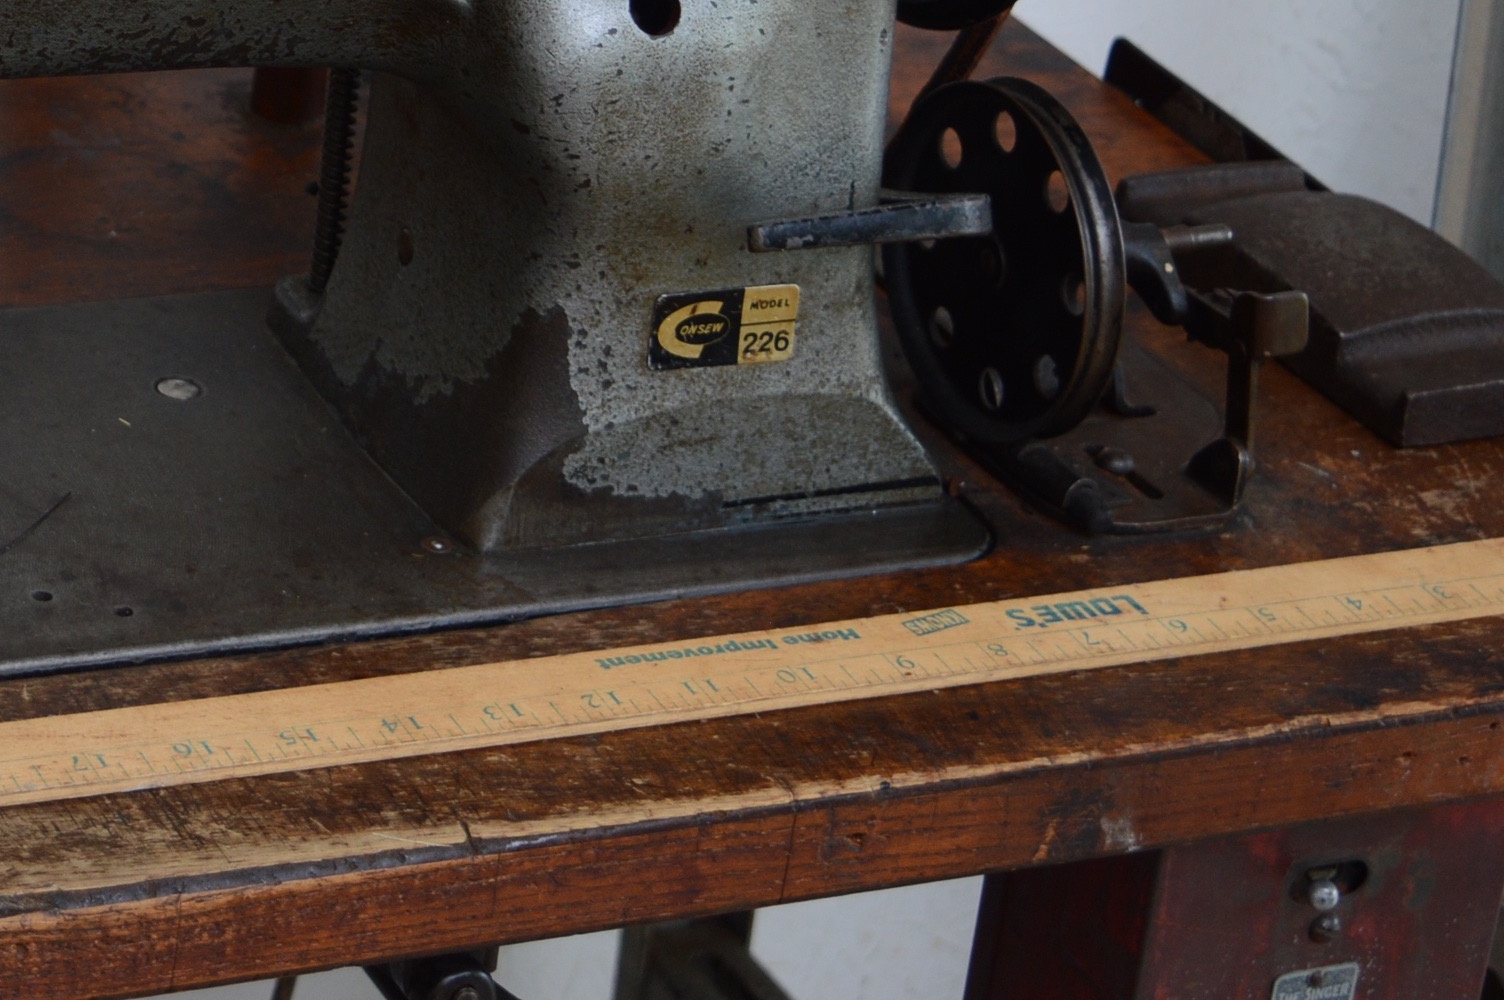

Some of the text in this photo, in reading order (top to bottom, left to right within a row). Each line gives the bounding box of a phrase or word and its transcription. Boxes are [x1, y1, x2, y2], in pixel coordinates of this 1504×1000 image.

[750, 299, 790, 310] MODEL
[743, 330, 790, 353] 226
[1432, 585, 1457, 600] 3
[1346, 597, 1363, 611] 4
[1258, 607, 1277, 621] 5
[594, 594, 1150, 670] LOWE'S KNOWS Home Improvement
[1169, 619, 1188, 633] 6
[1082, 631, 1100, 645] 7
[987, 643, 1009, 657] 8
[896, 655, 915, 670] 9
[776, 667, 818, 684] 10
[681, 679, 722, 697] 11
[580, 690, 624, 709] 12
[483, 703, 527, 720] 13
[381, 715, 425, 733] 14
[279, 728, 320, 745] 15
[173, 741, 215, 758] 16
[72, 753, 113, 772] 17
[1305, 982, 1351, 1000] SINGER
